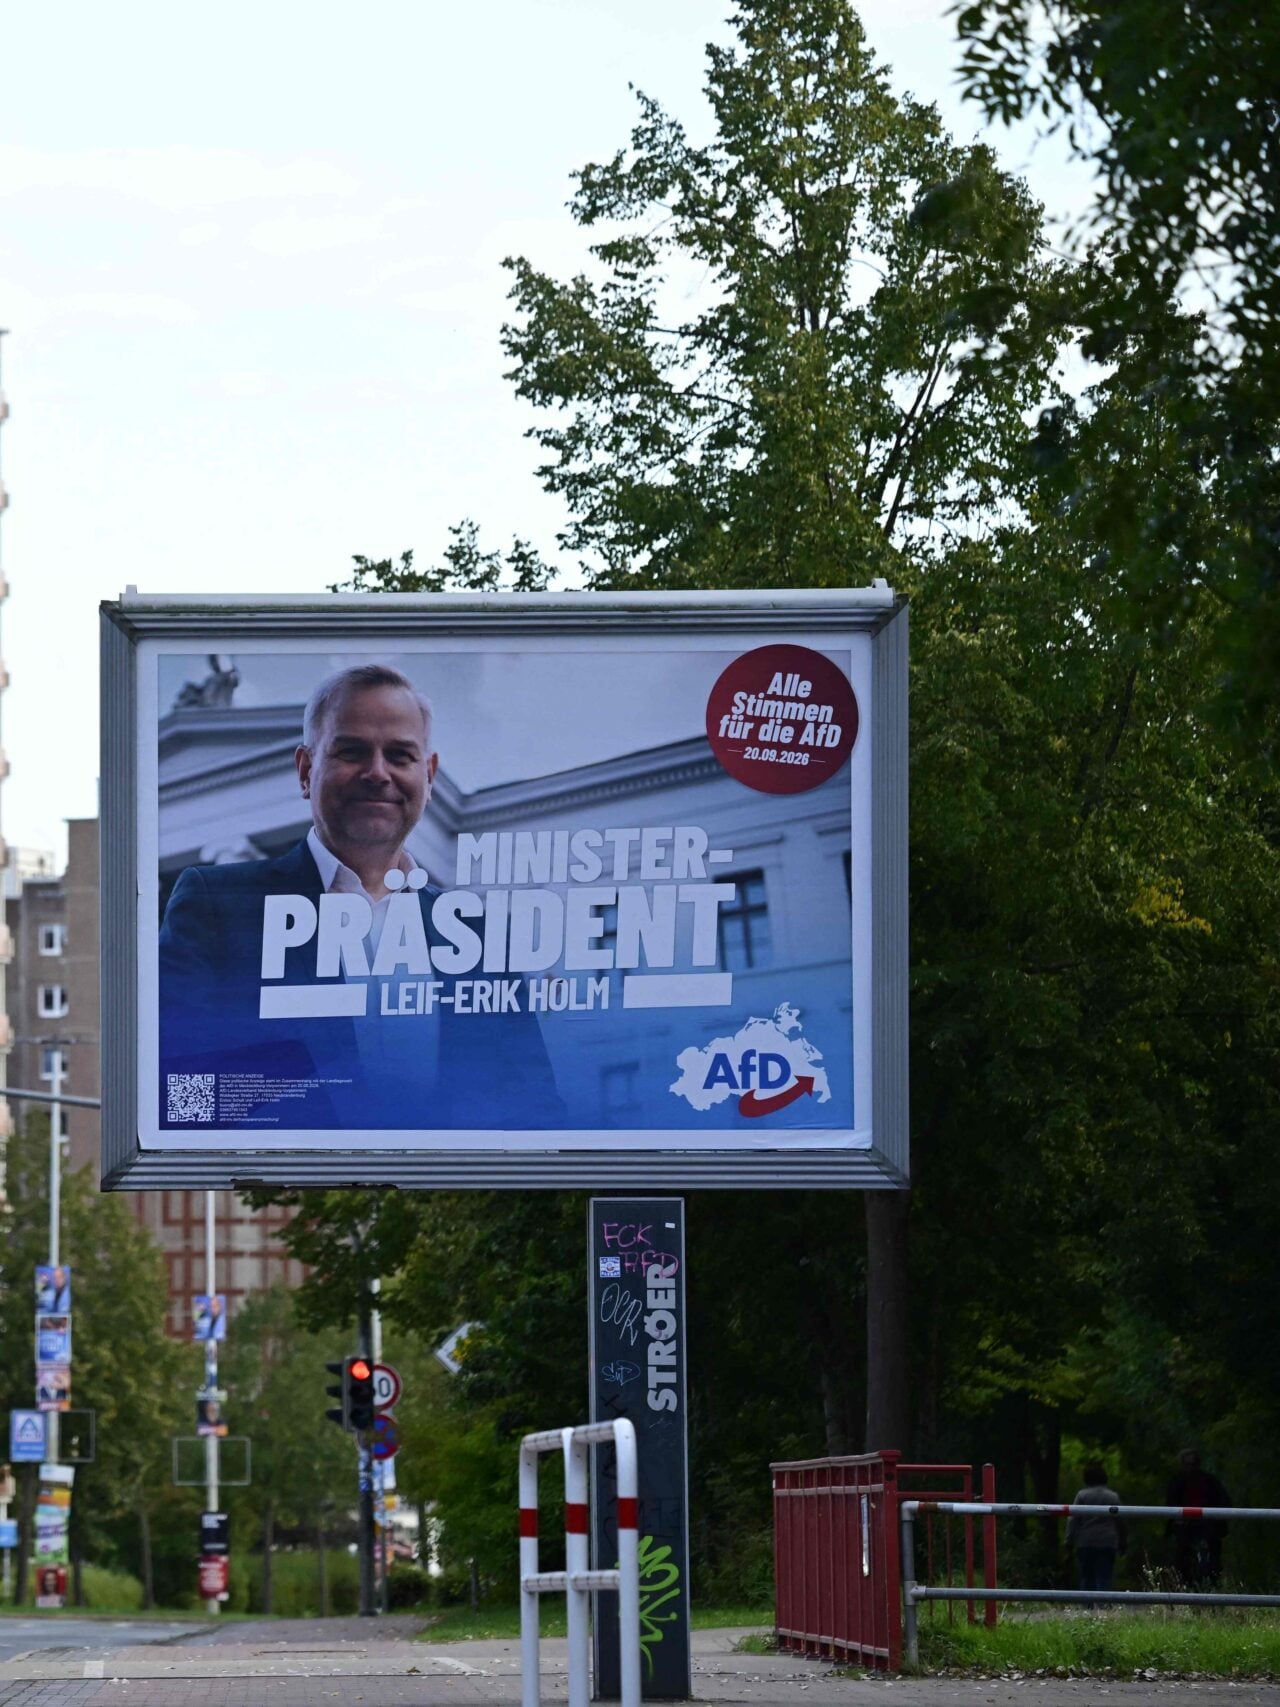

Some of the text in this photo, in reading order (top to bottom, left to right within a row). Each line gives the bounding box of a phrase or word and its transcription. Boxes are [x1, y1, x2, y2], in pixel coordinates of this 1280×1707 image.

[767, 672, 812, 698] Alle
[731, 691, 834, 723] Stimmen
[718, 714, 842, 748] für die AfD
[743, 746, 810, 766] 20.09.2026
[455, 826, 733, 886] MINISTER-
[261, 868, 736, 979] PRÄSIDENT
[380, 976, 610, 1016] LEIF-ERIK HOLM
[702, 1049, 791, 1089] AfD
[603, 1222, 653, 1248] FCK
[643, 1263, 677, 1413] STRÖER
